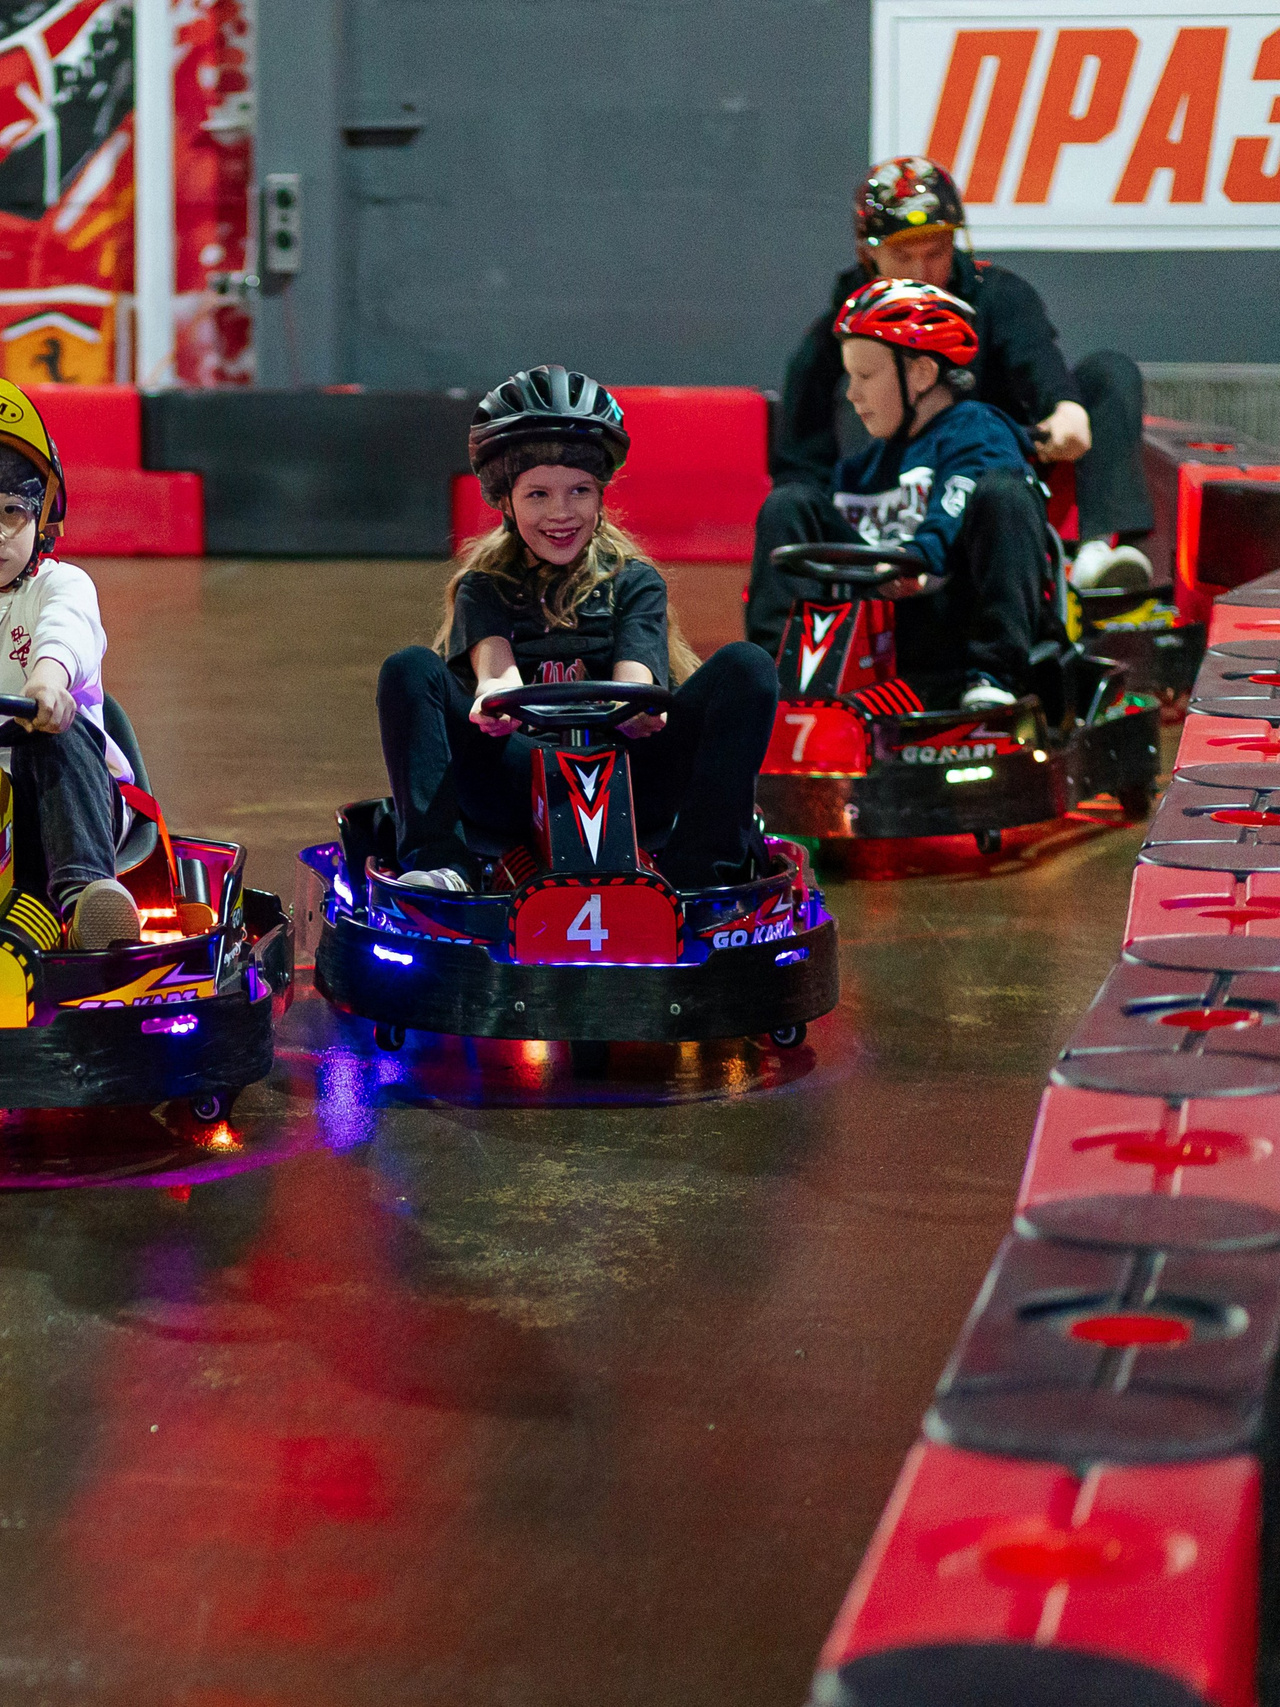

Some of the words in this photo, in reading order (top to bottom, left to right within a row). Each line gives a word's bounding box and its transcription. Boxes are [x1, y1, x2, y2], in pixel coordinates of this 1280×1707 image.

[784, 714, 818, 763] 7
[566, 893, 609, 952] 4
[712, 928, 748, 949] GO
